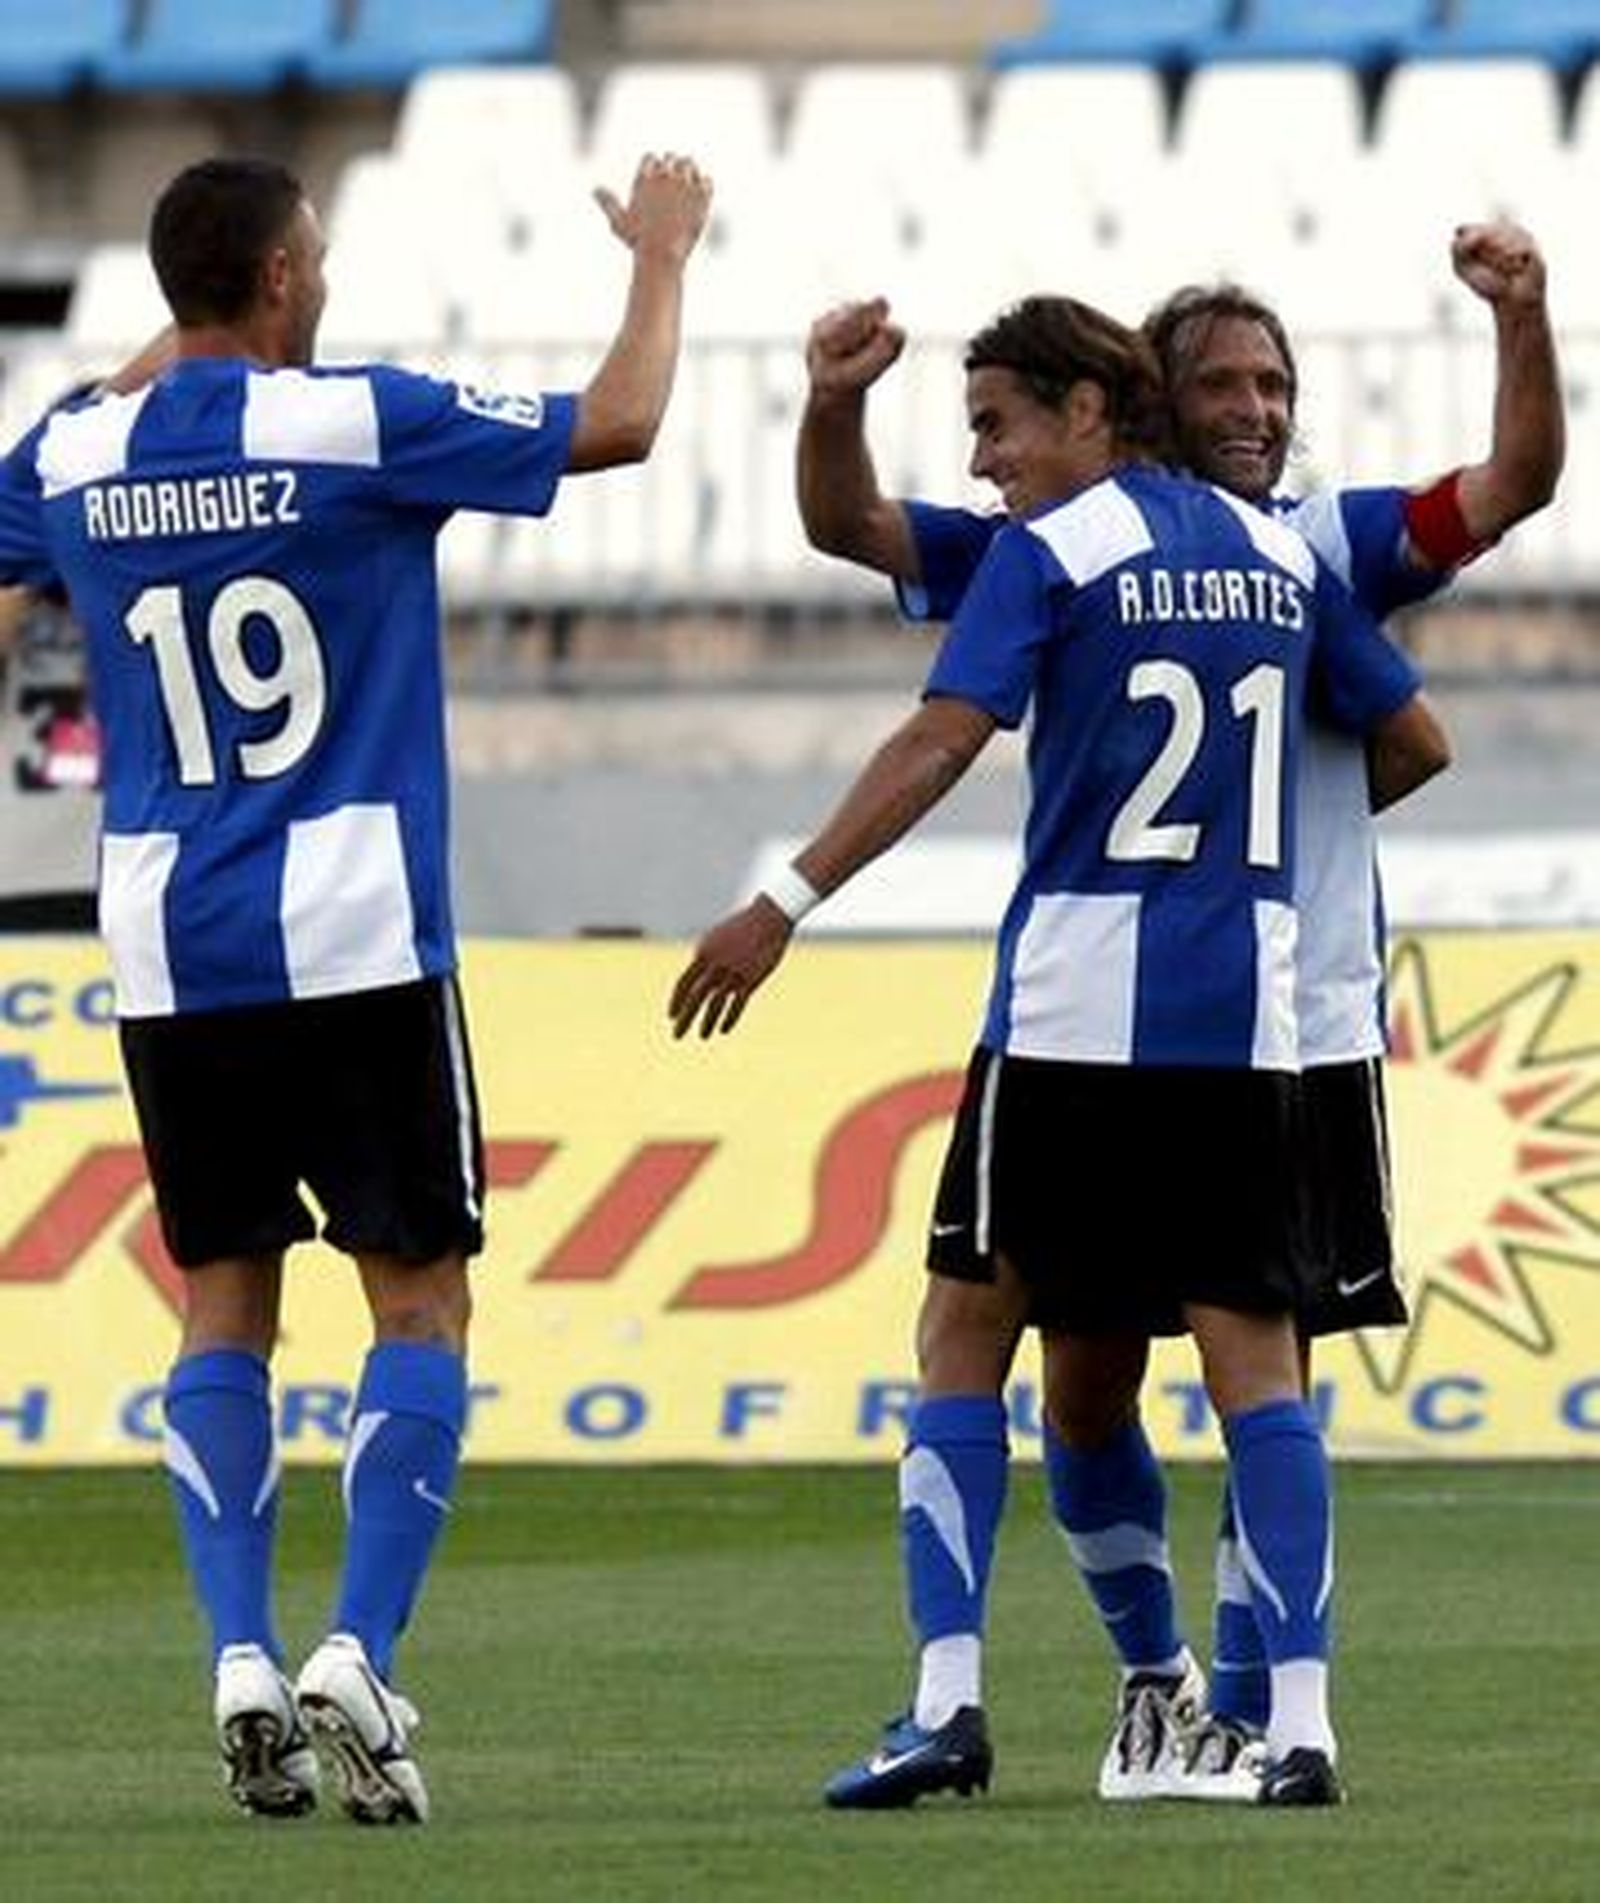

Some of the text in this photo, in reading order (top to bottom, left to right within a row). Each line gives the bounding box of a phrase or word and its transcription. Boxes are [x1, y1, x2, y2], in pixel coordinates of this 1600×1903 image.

[85, 469, 300, 540] RODRIGUEZ
[124, 574, 327, 786] 19
[1104, 658, 1286, 870] 21
